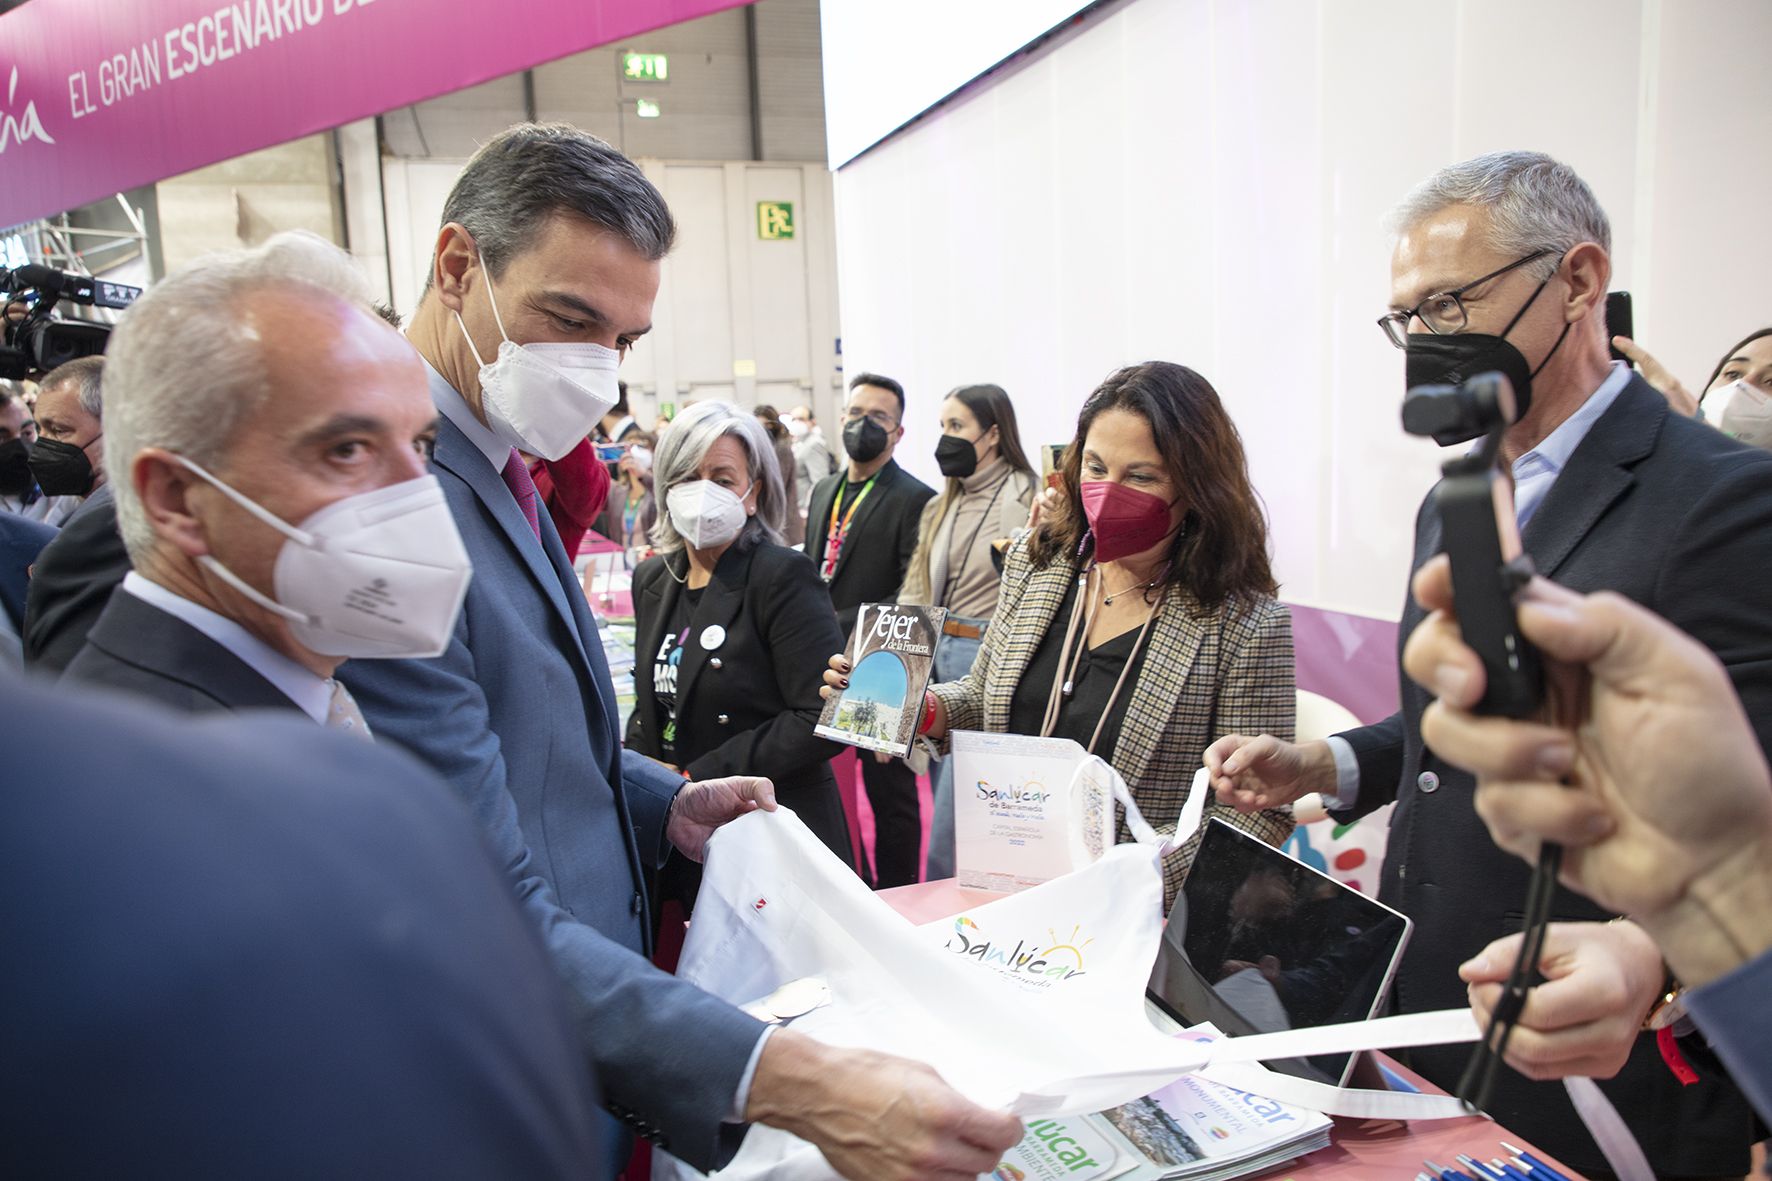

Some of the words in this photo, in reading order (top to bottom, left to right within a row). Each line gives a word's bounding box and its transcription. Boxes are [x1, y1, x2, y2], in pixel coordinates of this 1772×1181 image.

[68, 70, 97, 119] EL
[98, 38, 161, 107] GRAN
[164, 0, 325, 80] ESCENARIO
[853, 605, 919, 668] Vejer
[887, 639, 897, 650] de
[896, 640, 904, 651] la
[903, 640, 929, 654] Frontera
[976, 780, 1051, 803] Sanlúcar
[944, 917, 1086, 980] Sanlúcar
[1183, 1077, 1248, 1135] MONUMENTAL
[1016, 1144, 1058, 1181] MBIENTE
